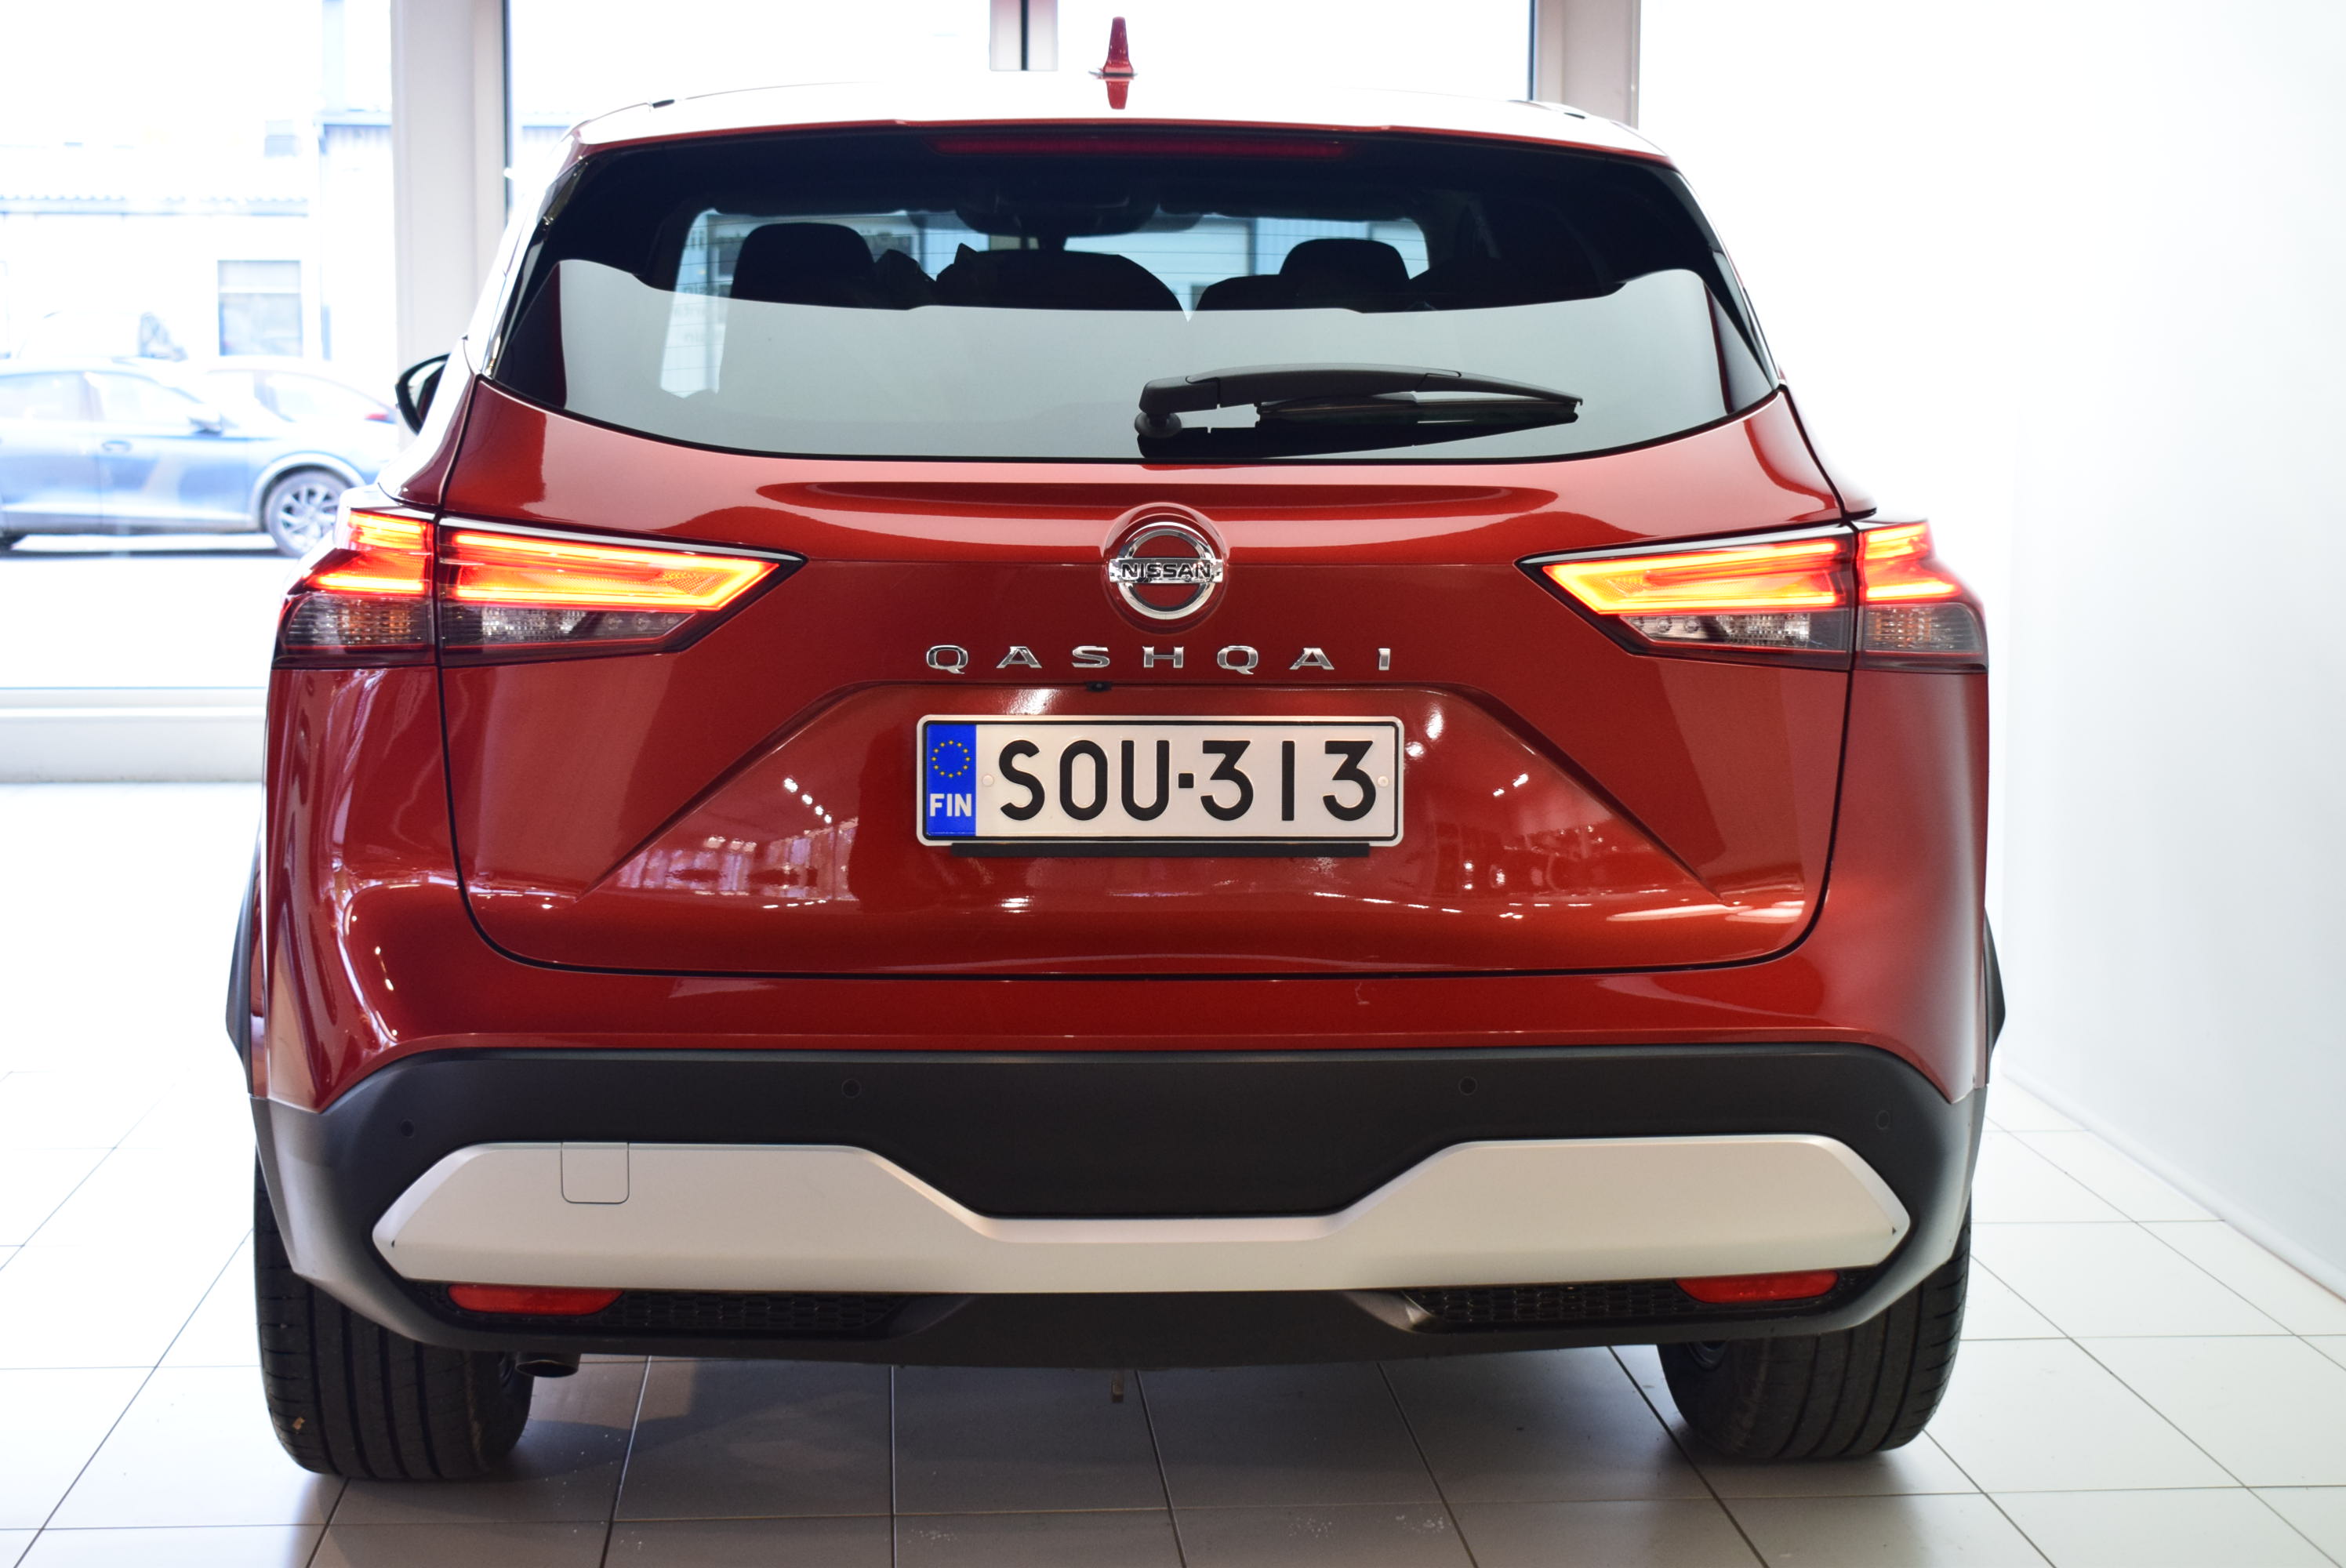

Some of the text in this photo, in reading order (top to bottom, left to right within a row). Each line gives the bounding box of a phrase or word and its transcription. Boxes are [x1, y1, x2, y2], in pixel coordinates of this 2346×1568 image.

[1120, 562, 1211, 579] NISSAN
[926, 644, 1391, 674] QASHQAI
[997, 739, 1377, 822] SOU-313
[929, 793, 972, 817] FIN
